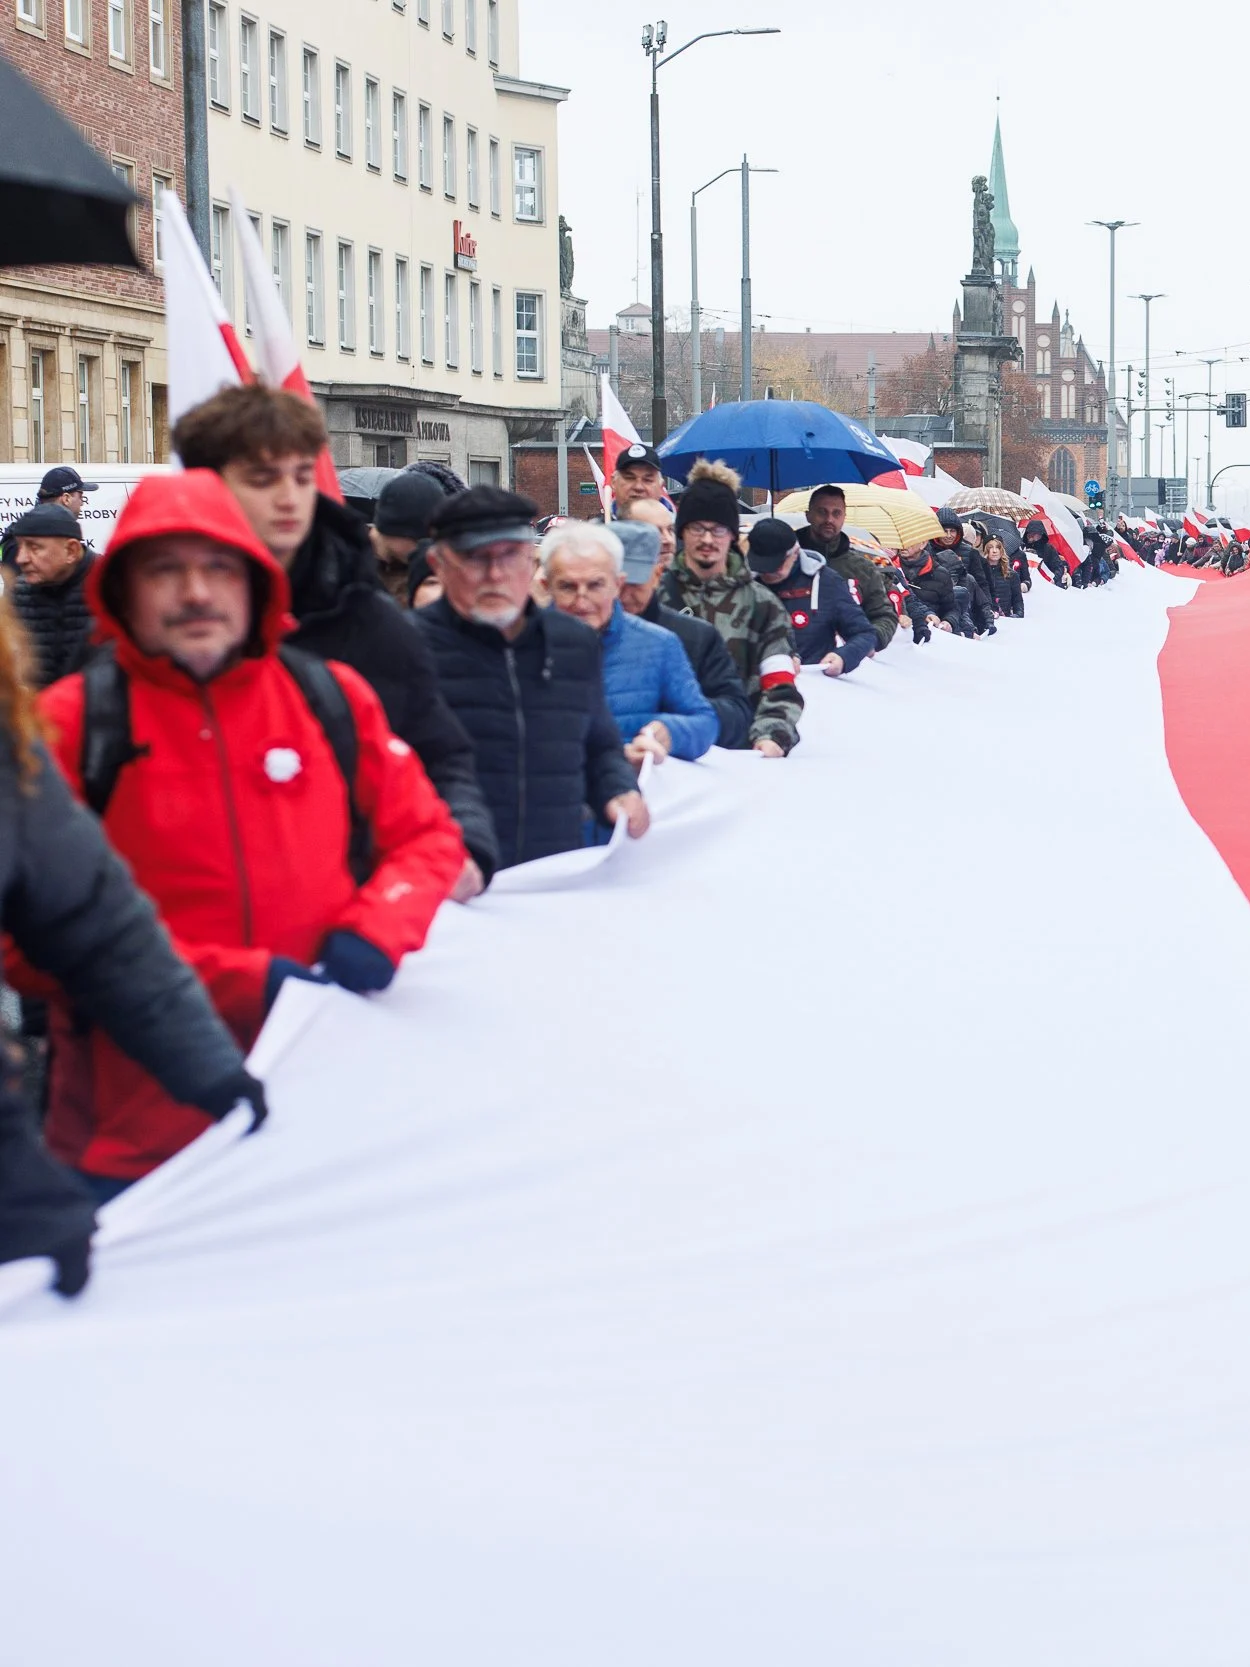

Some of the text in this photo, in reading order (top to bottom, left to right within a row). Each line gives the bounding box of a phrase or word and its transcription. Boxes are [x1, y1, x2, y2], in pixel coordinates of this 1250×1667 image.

[416, 420, 451, 442] AMKOWA
[15, 496, 34, 507] NA
[77, 509, 118, 520] EROBY
